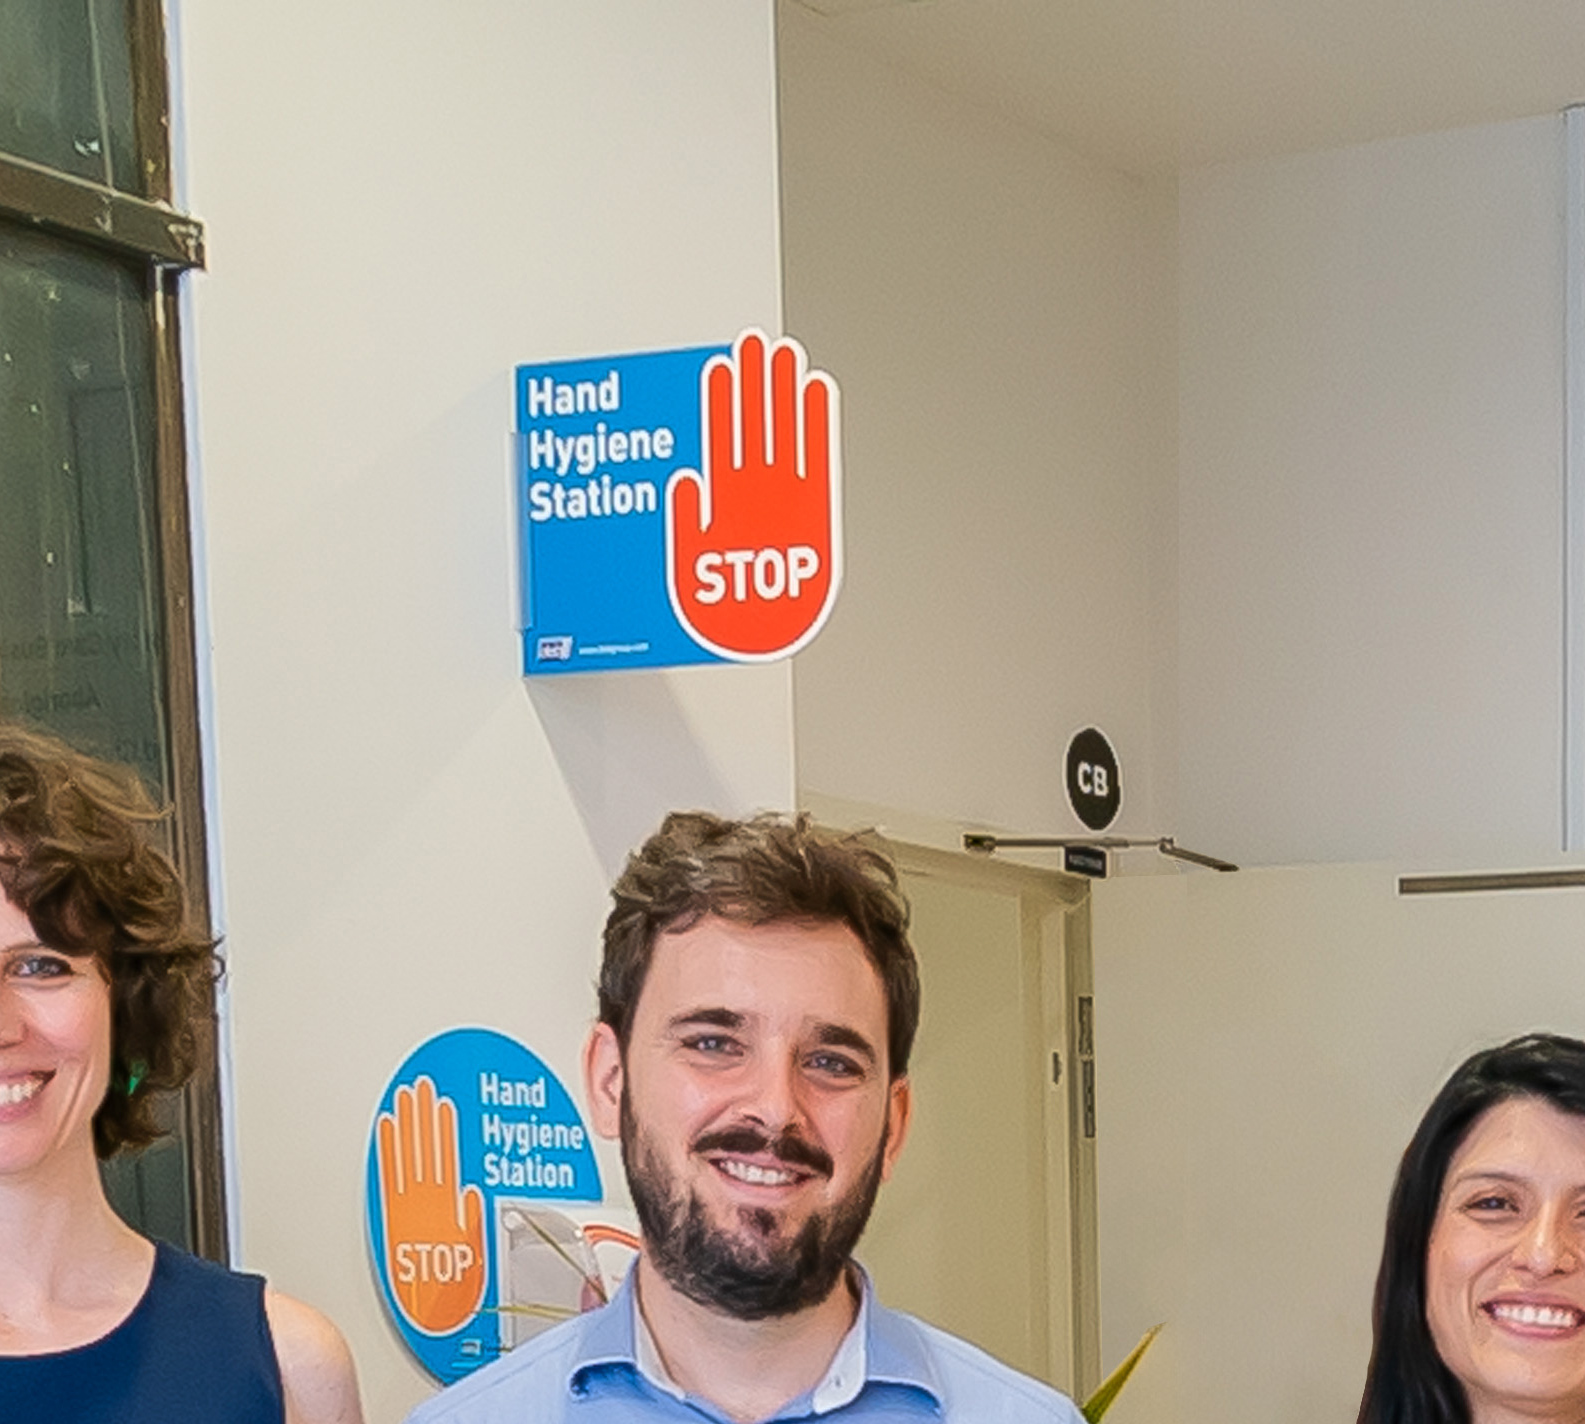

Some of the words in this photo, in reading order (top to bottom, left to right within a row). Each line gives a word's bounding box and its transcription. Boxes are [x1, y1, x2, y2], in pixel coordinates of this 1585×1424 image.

[527, 369, 621, 419] Hand
[528, 422, 675, 477] Hygiene
[528, 474, 659, 523] Station
[693, 545, 821, 605] STOP
[1076, 760, 1109, 797] CB
[479, 1072, 547, 1108] Hand
[481, 1112, 586, 1155] Hygiene
[483, 1152, 576, 1189] Station
[395, 1243, 475, 1283] STOP
